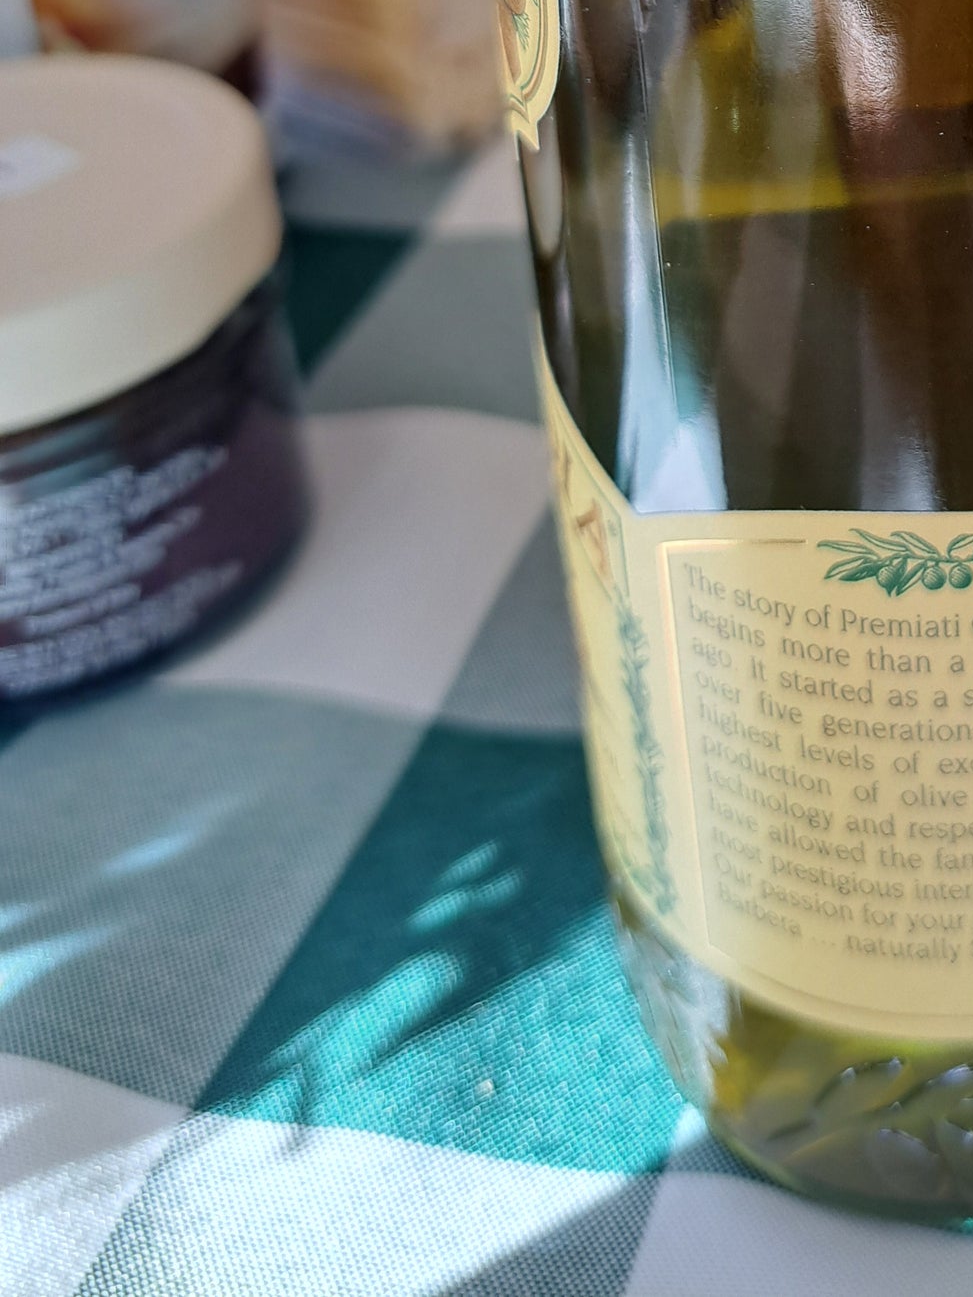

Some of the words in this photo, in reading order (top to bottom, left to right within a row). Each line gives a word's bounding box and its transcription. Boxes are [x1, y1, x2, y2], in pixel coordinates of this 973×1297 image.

[685, 563, 726, 600] The
[734, 589, 796, 626] story
[805, 605, 831, 628] of
[841, 608, 960, 638] Premiati
[689, 598, 766, 647] begins
[782, 636, 850, 666] more
[867, 646, 931, 673] than
[950, 654, 965, 673] a
[695, 670, 740, 704] over
[760, 691, 802, 724] five
[780, 670, 873, 704] started
[888, 689, 918, 707] as
[933, 690, 948, 707] a
[700, 695, 781, 752] highest
[800, 734, 875, 771] levels
[893, 751, 920, 775] of
[702, 734, 832, 795] production
[853, 781, 879, 803] of
[901, 783, 968, 808] olive
[705, 763, 833, 830] technology
[847, 814, 896, 837] and
[709, 788, 759, 832] have
[769, 822, 866, 863] allowed
[880, 844, 922, 870] the
[713, 826, 762, 864] most
[772, 855, 904, 899] prestigious
[714, 853, 752, 884] Our
[761, 879, 853, 920] passion
[863, 903, 898, 926] for
[907, 913, 963, 932] your
[847, 934, 960, 963] naturally
